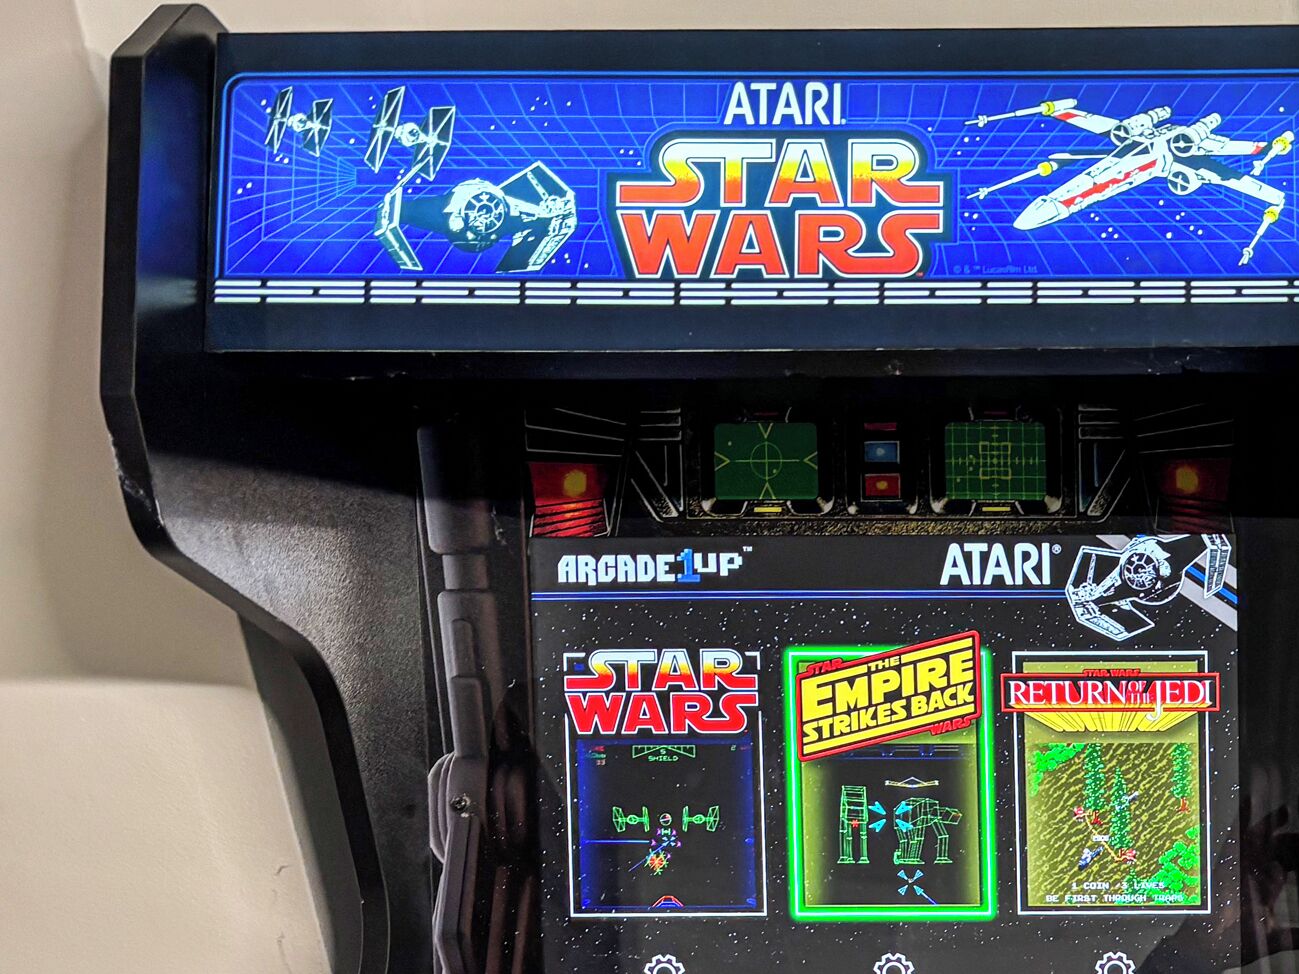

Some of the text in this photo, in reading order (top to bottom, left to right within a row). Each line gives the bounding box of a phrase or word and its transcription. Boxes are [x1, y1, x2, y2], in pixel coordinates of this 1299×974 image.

[724, 82, 841, 125] ATARI
[616, 138, 944, 207] STAR
[616, 209, 944, 278] WARS
[564, 648, 759, 691] STAR
[806, 657, 844, 676] STAR
[868, 655, 900, 673] THE
[1083, 669, 1140, 678] STAR WARS
[802, 649, 973, 722] EMPIRE
[1008, 679, 1127, 706] RETURN
[1147, 679, 1214, 721] JEDI
[564, 691, 759, 734] WARS
[803, 682, 975, 743] STRIKES BACK
[929, 717, 972, 736] WARS
[1046, 894, 1059, 902] BE
[1064, 894, 1097, 902] FIRST
[1104, 894, 1146, 902] THROUGH
[1084, 882, 1110, 890] COIN
[1134, 882, 1165, 890] LIVES
